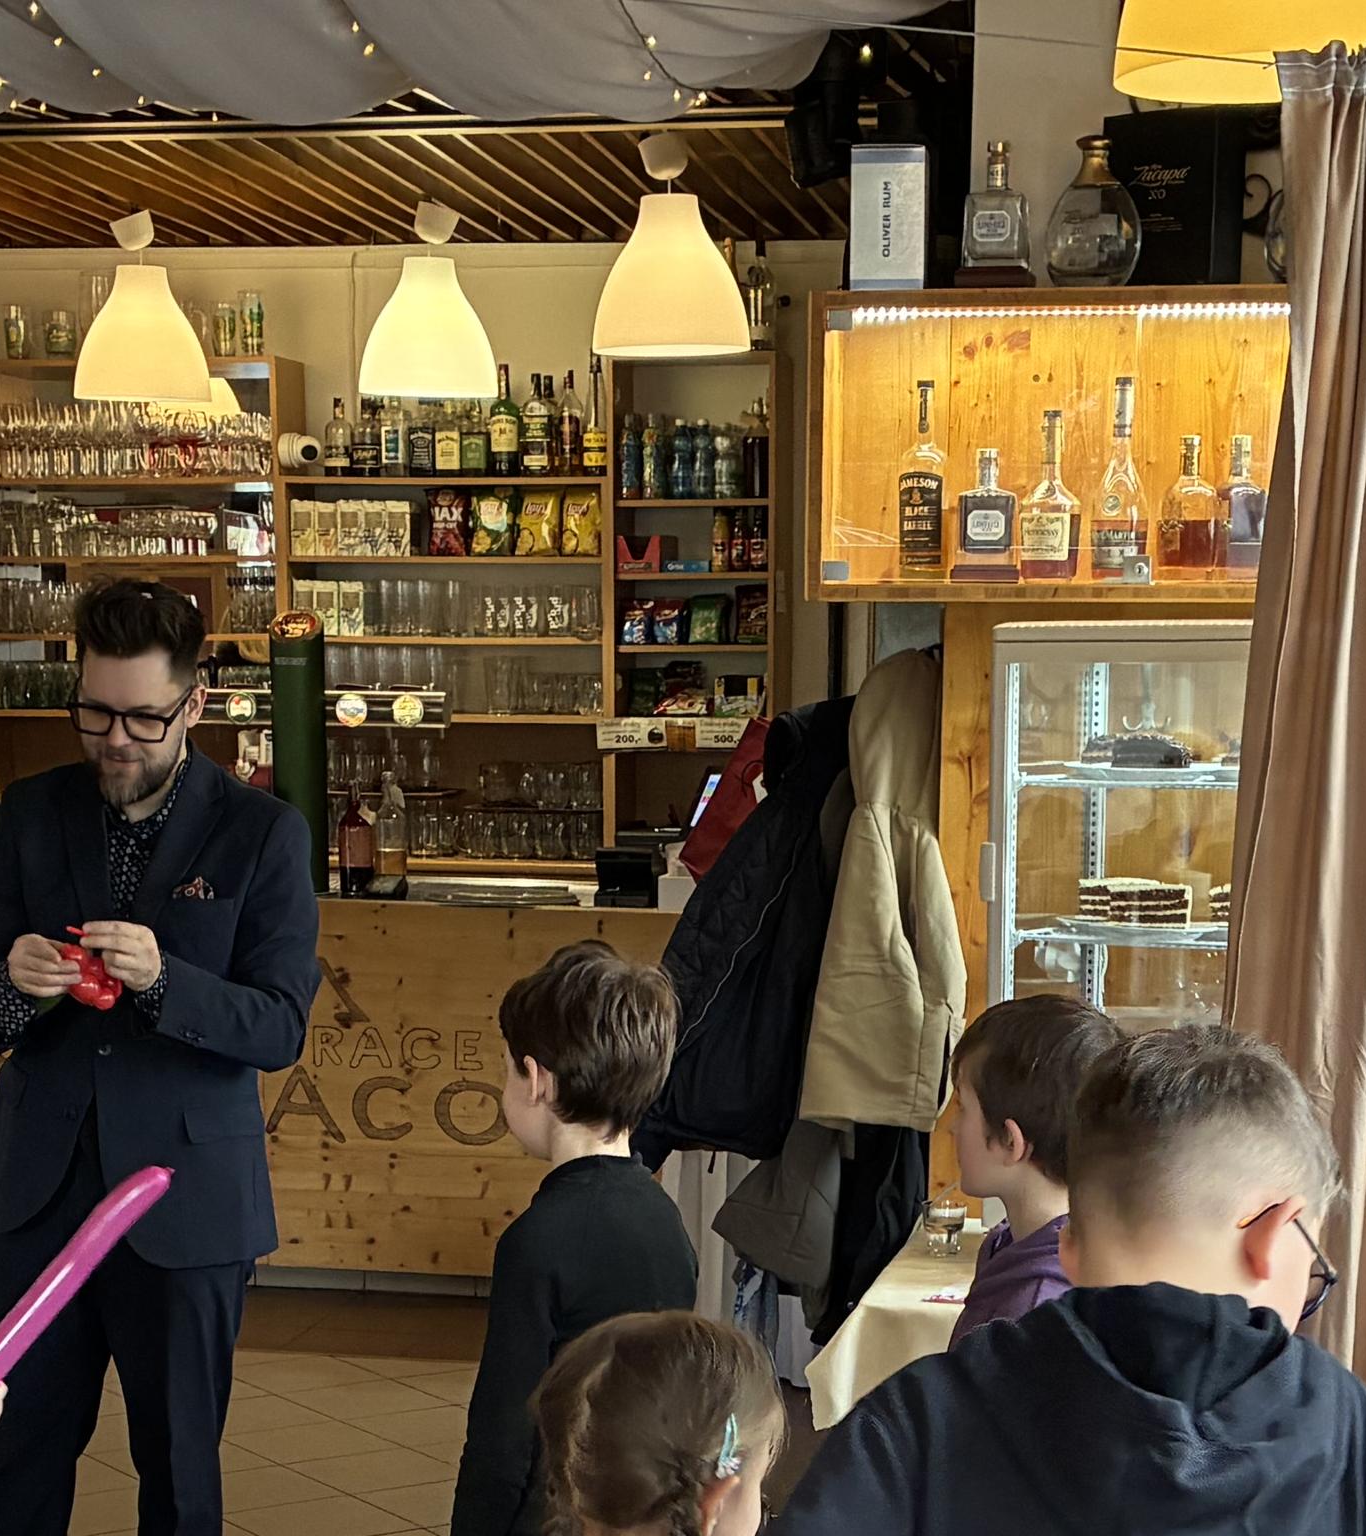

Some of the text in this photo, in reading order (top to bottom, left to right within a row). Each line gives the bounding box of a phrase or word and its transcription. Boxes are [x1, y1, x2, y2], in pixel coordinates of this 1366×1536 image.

[881, 181, 892, 258] OLIVER RUM
[900, 477, 939, 491] JAMESON
[615, 734, 642, 745] 200,-
